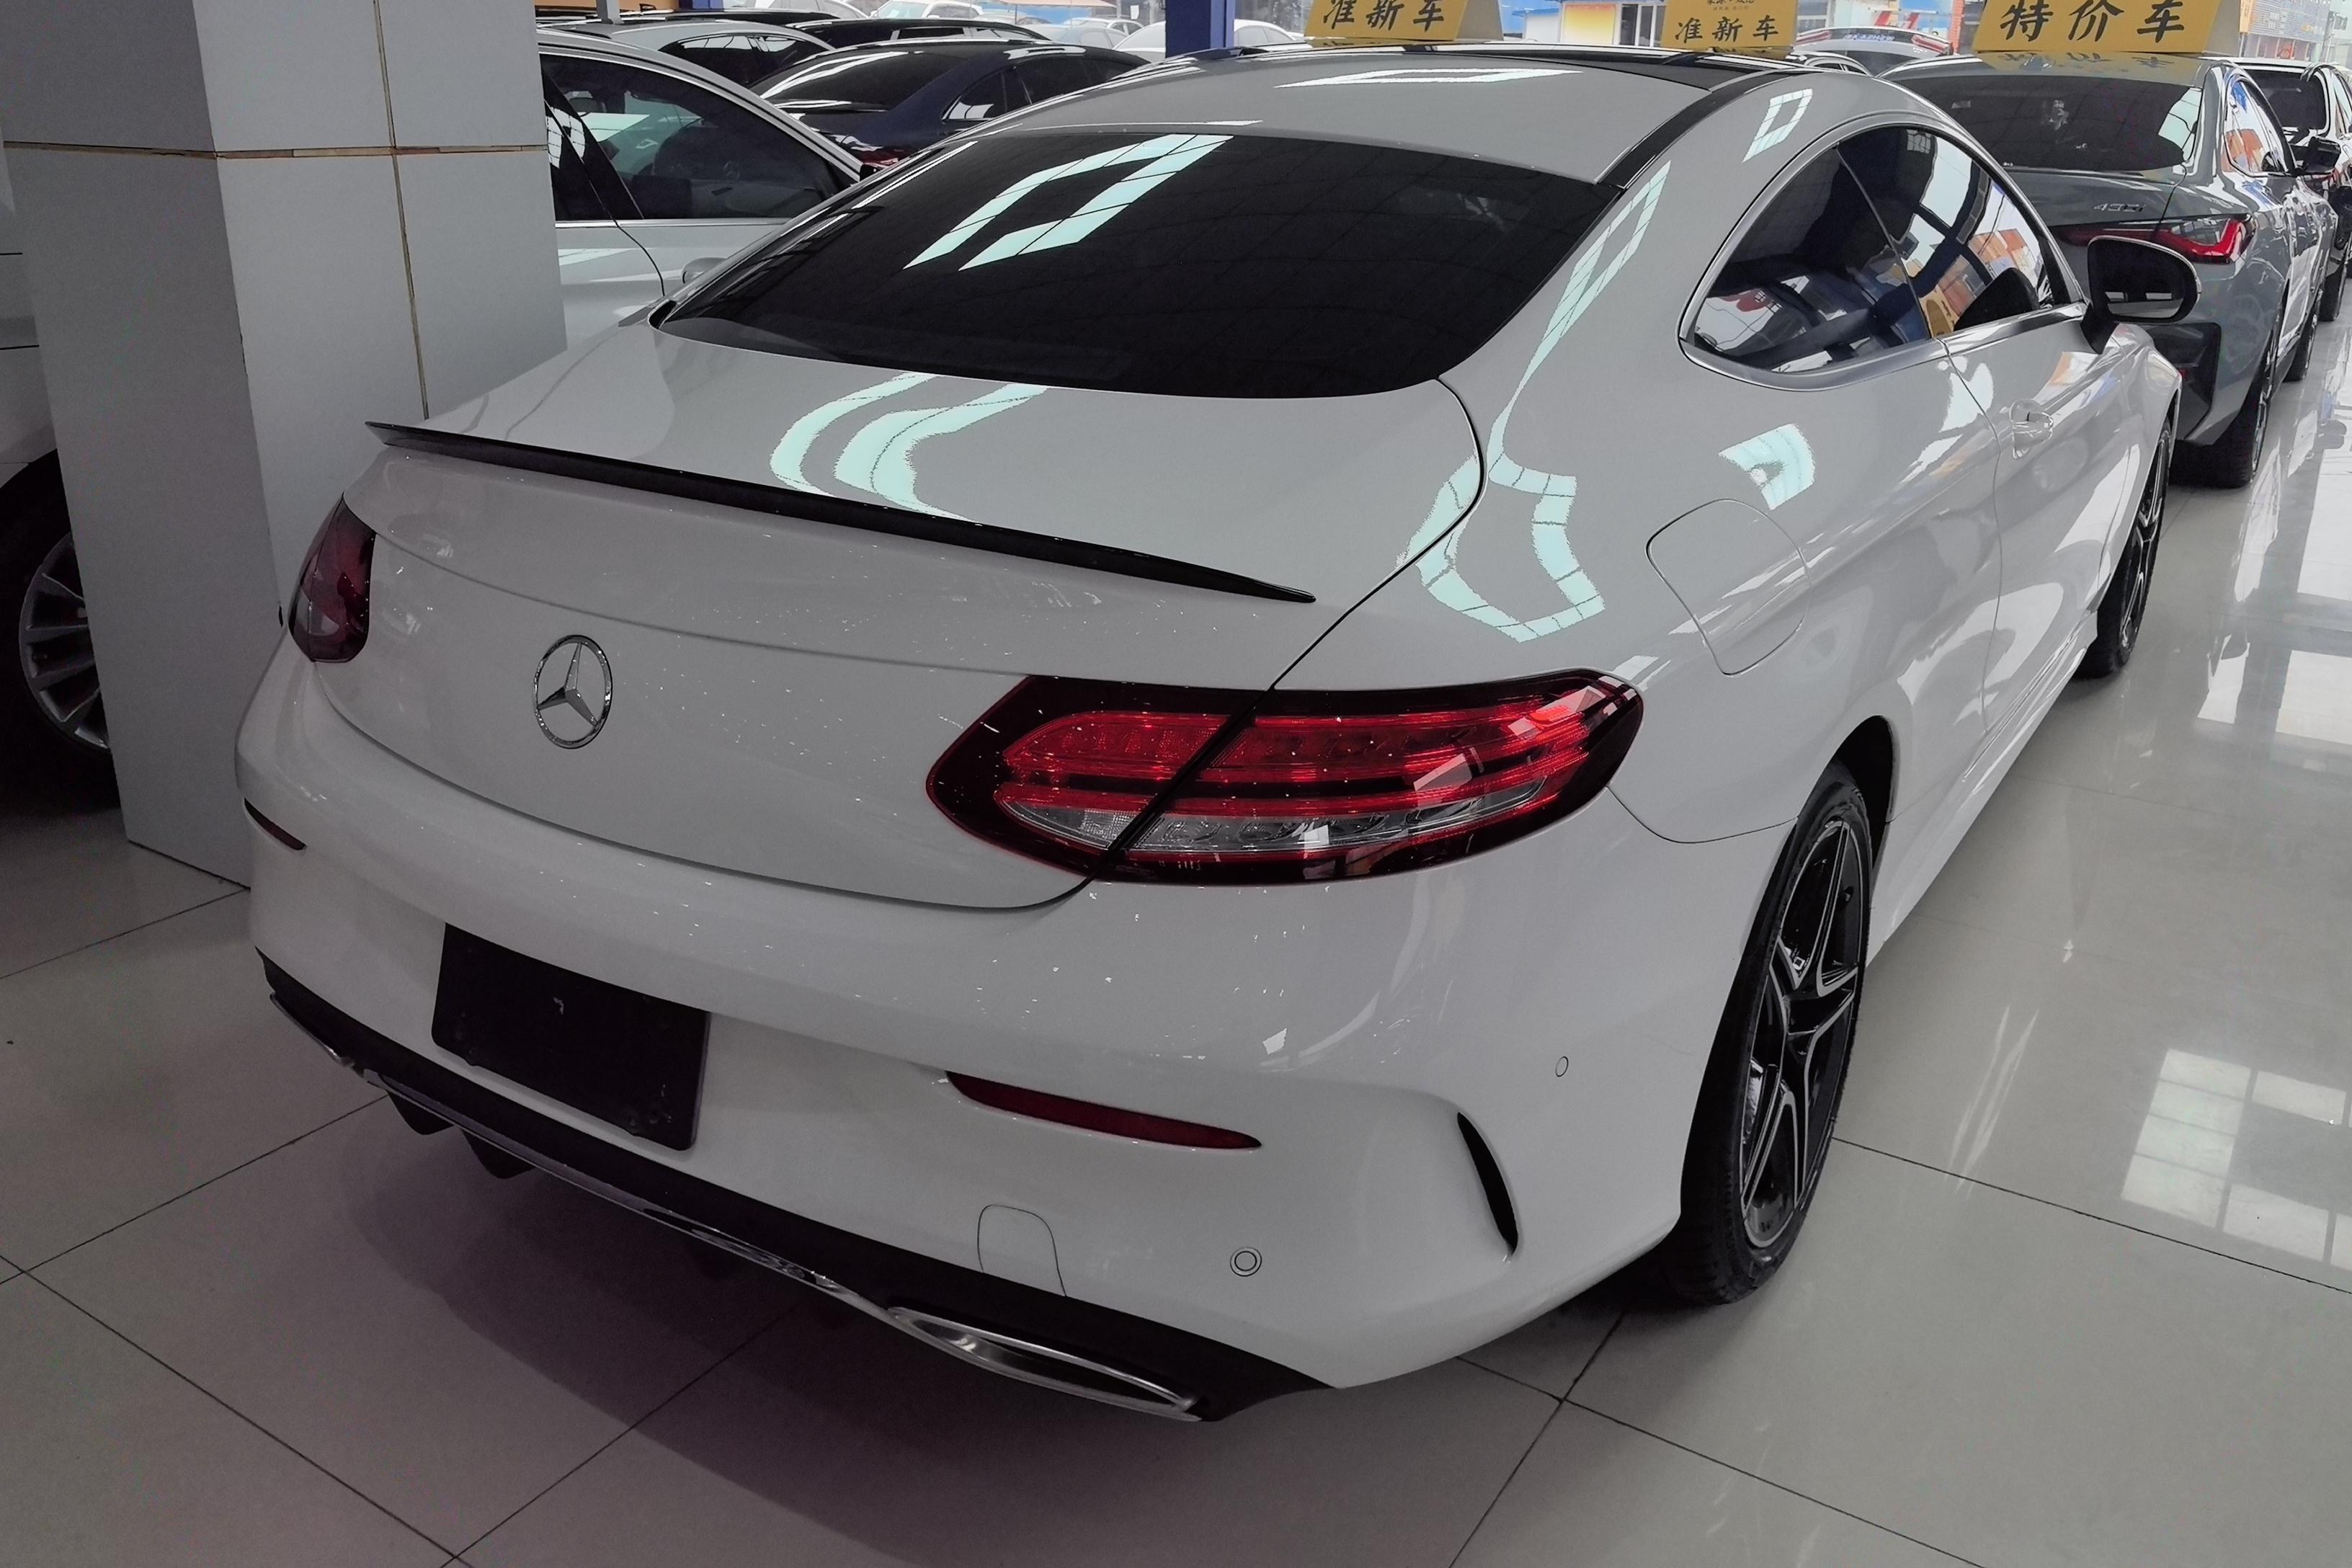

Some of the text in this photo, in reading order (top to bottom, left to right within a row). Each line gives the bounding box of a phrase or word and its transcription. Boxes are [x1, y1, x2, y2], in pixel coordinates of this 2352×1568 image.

[1323, 0, 1444, 32] 准新车
[1675, 14, 1779, 44] 准新车
[2000, 0, 2185, 43] 特价车
